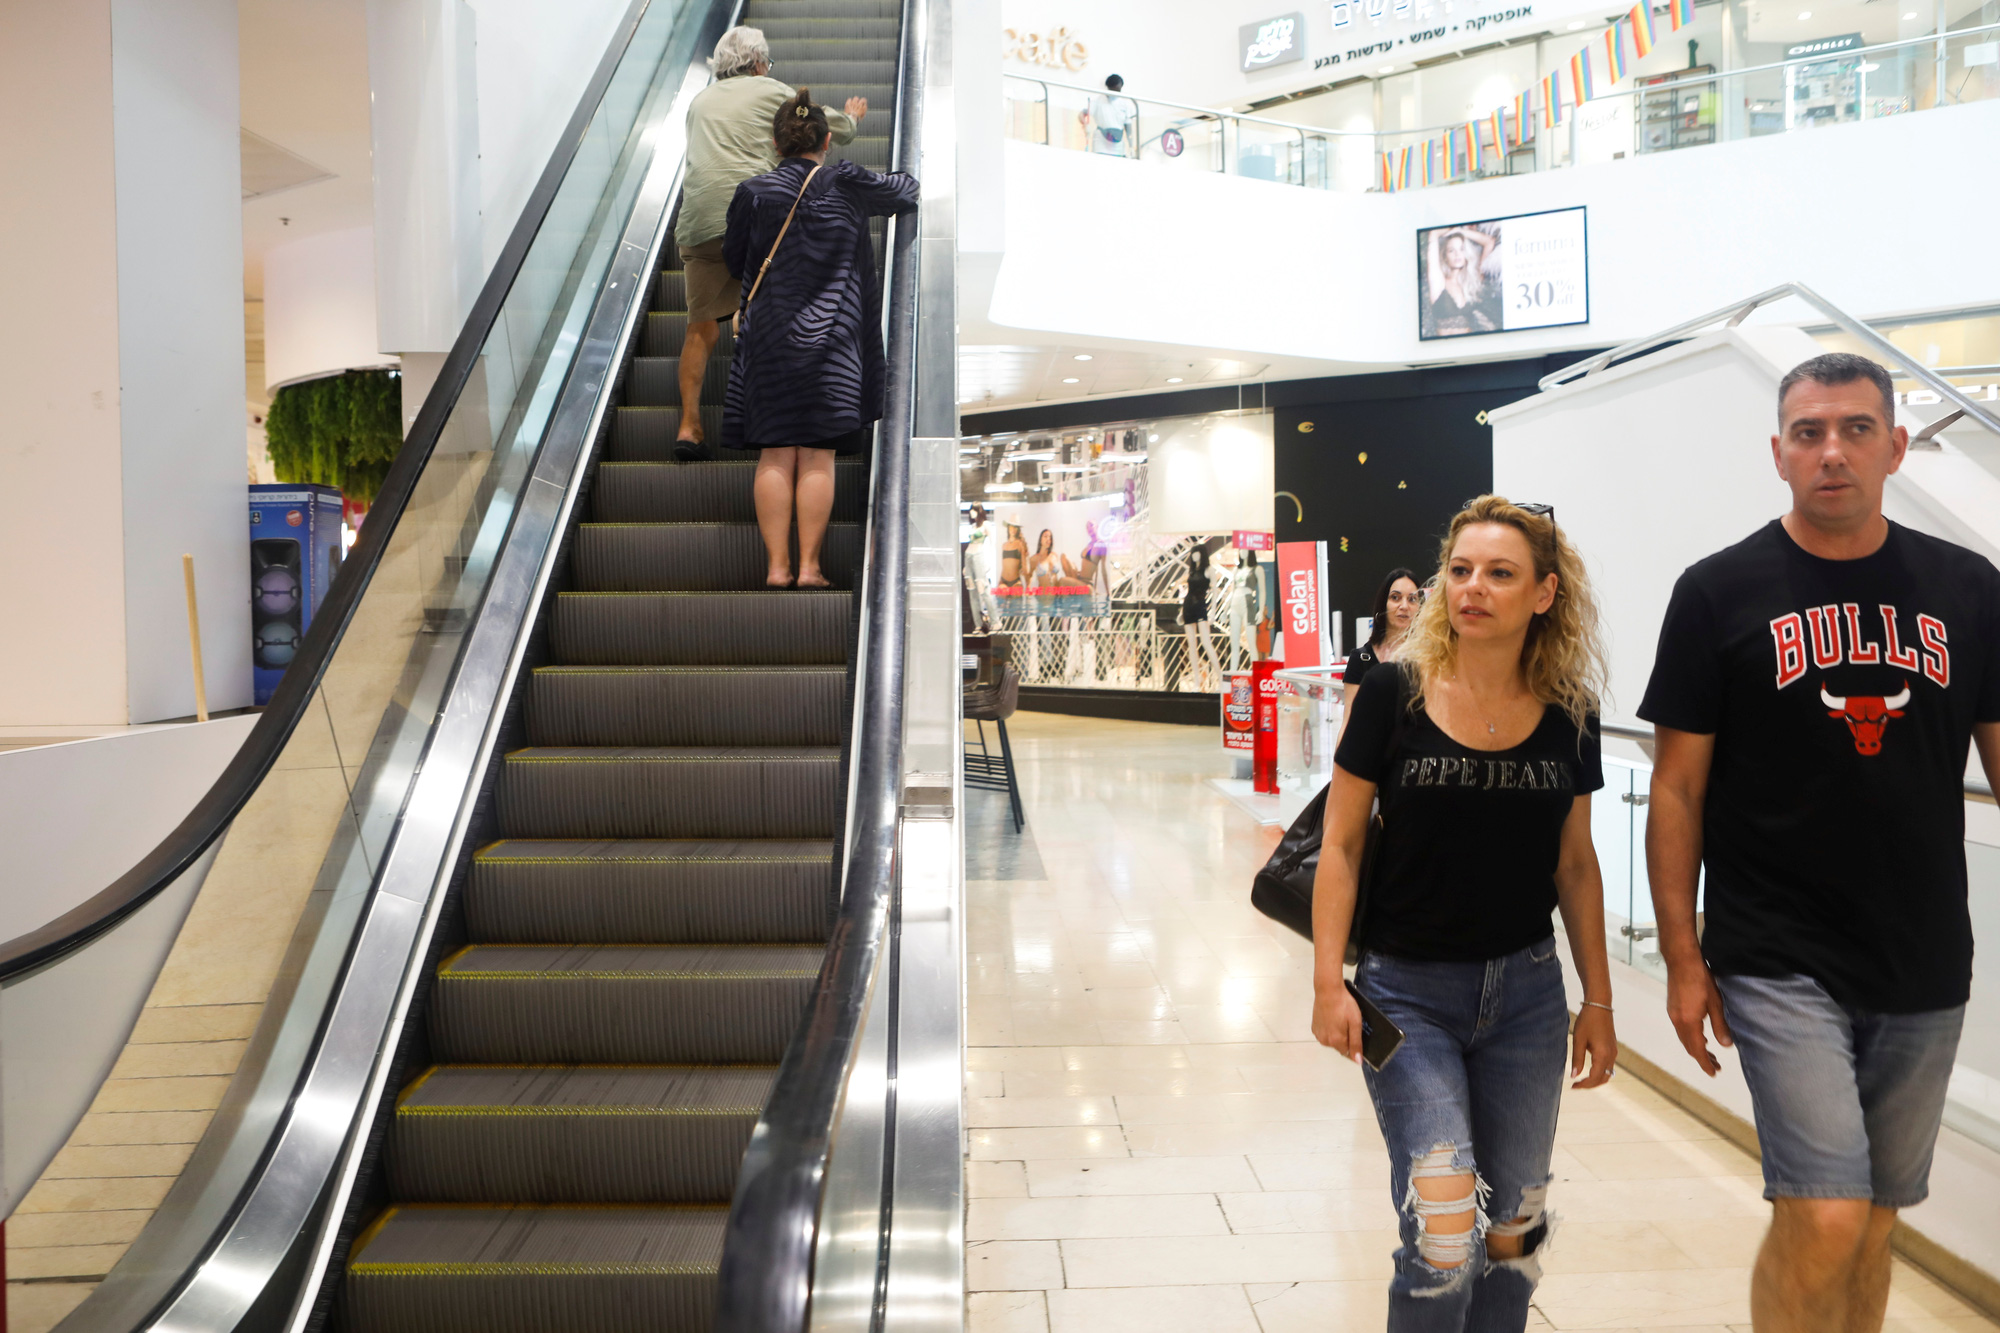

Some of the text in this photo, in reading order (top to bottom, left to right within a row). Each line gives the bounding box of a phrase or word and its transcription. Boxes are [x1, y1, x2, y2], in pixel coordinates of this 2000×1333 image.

[1466, 5, 1534, 32] אופטיקה
[1410, 25, 1447, 44] שמש
[1346, 38, 1394, 61] עדשות
[1313, 54, 1341, 71] מגע
[1165, 133, 1178, 149] A
[1287, 570, 1309, 635] Golan
[1769, 602, 1951, 690] BULLS
[1400, 757, 1478, 789] PEPE
